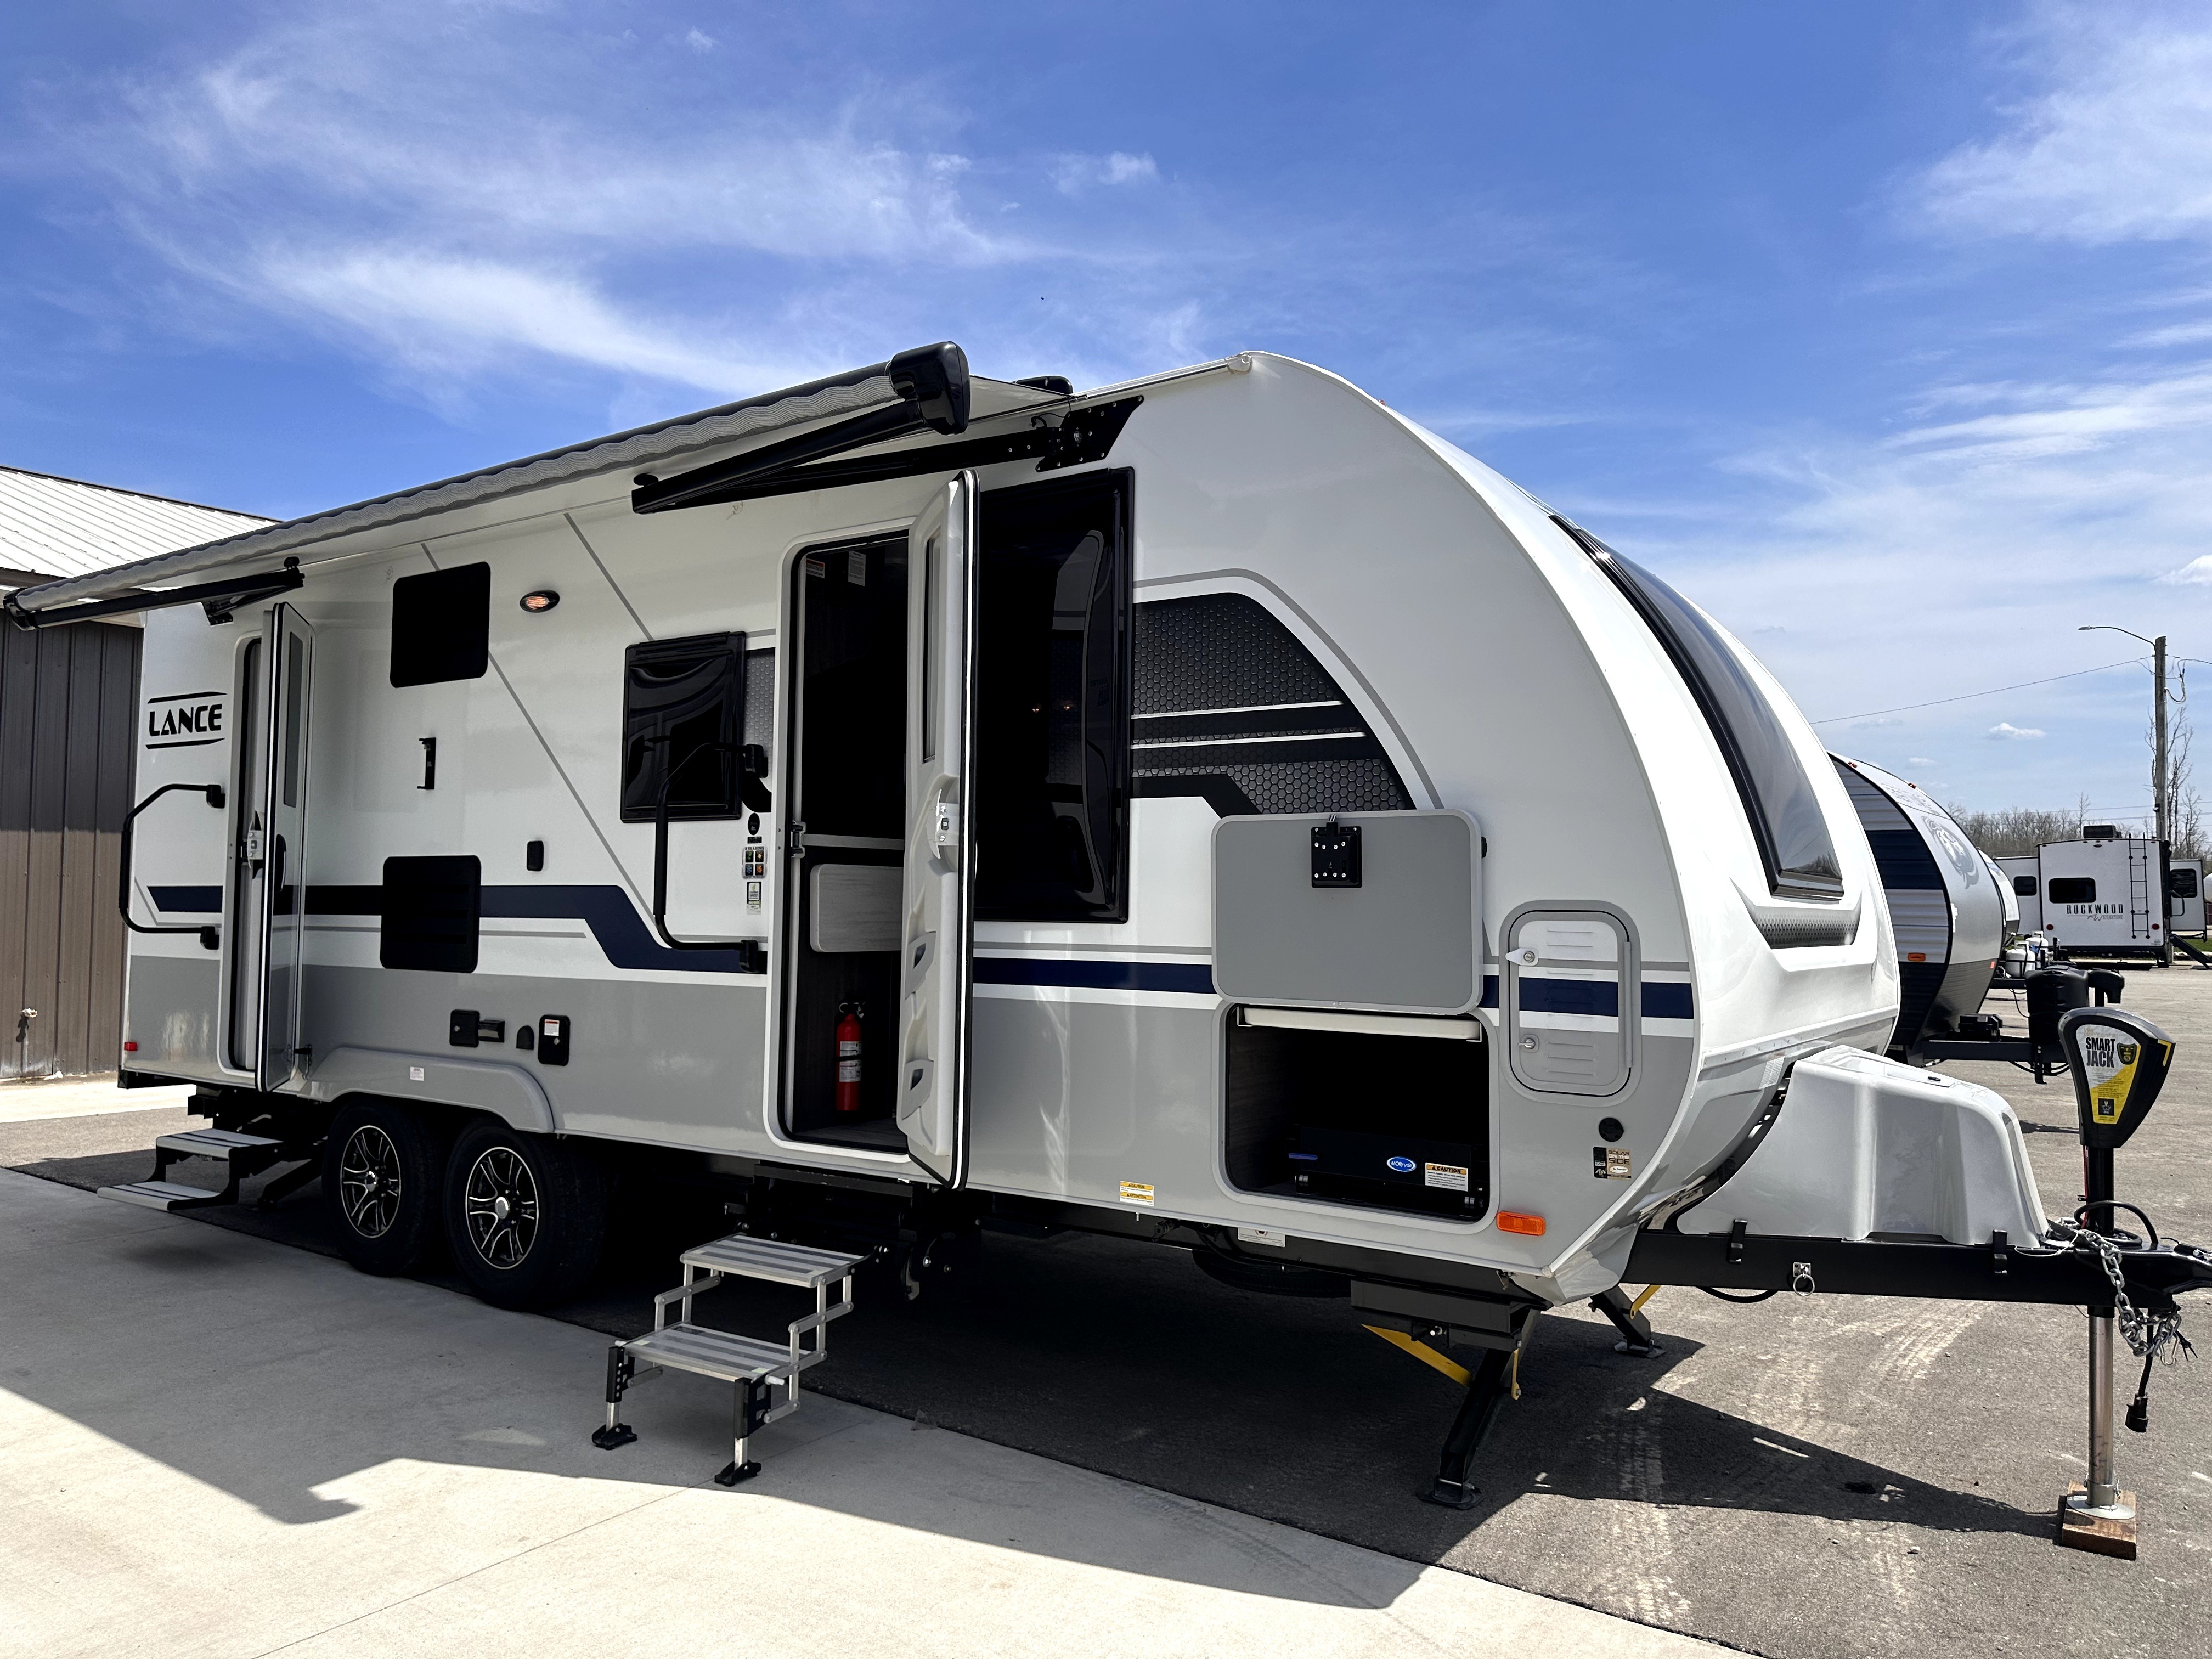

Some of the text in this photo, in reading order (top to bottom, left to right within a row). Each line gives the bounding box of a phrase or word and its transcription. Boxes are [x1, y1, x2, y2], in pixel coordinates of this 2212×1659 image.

[149, 704, 222, 736] LANCE
[2067, 904, 2123, 914] ROCKWOOD
[2086, 1037, 2115, 1051] SMART
[2086, 1049, 2115, 1068] JACK
[1437, 1166, 1461, 1174] CAUTION
